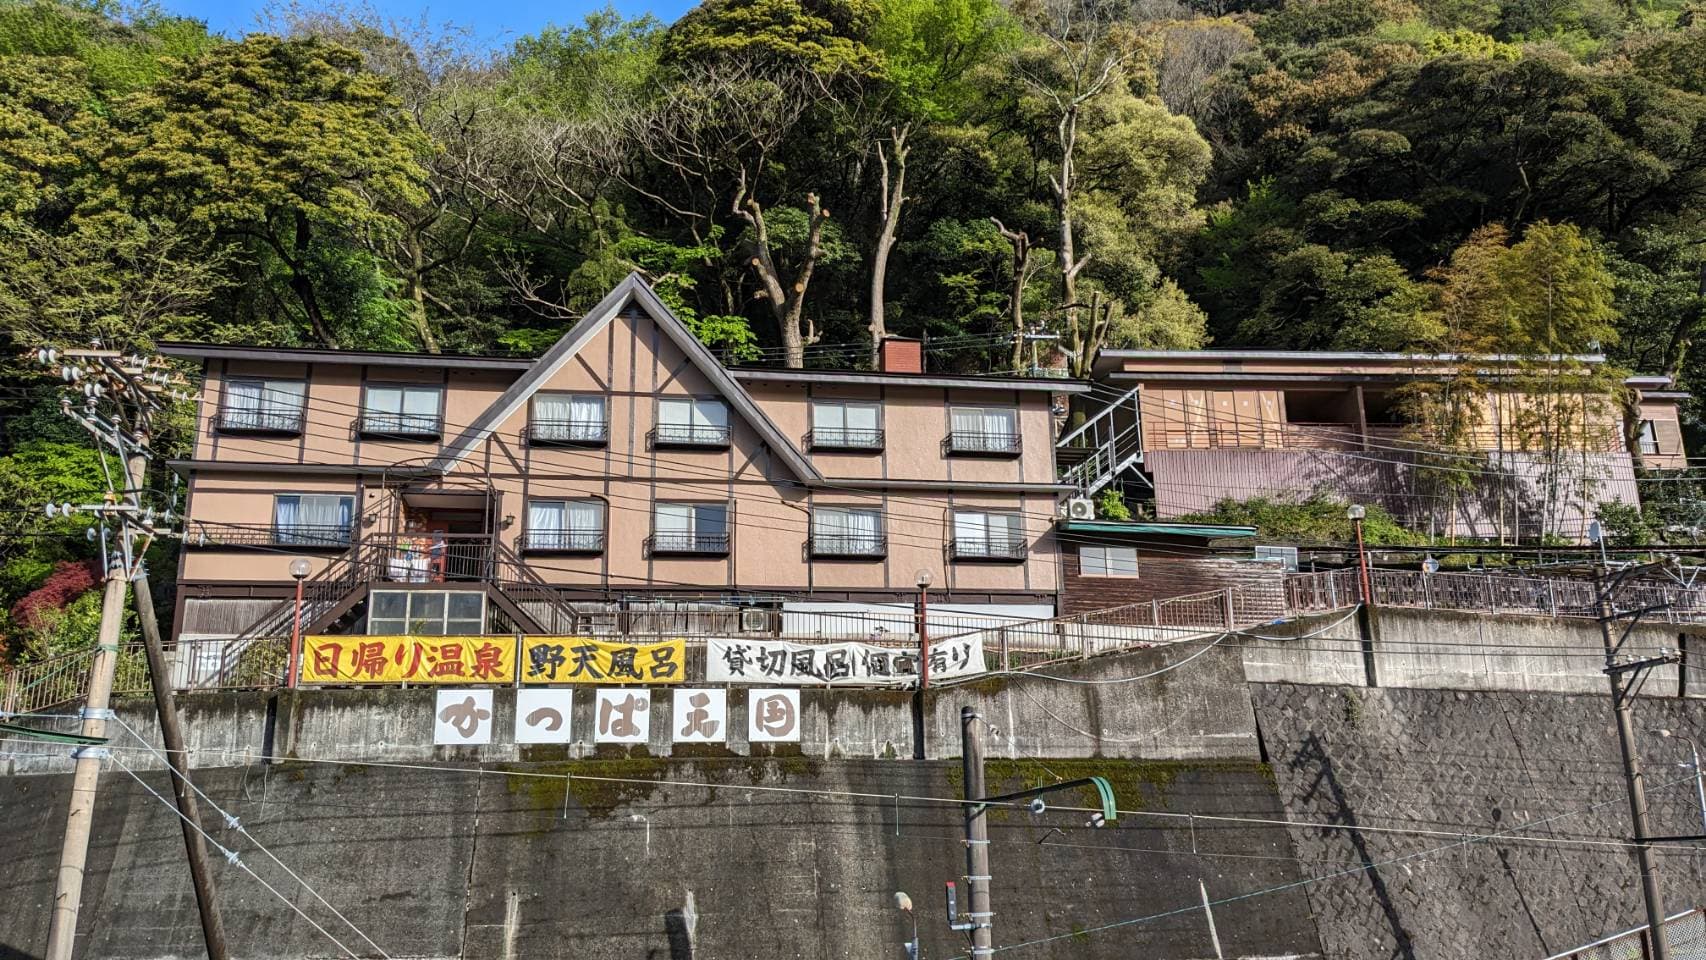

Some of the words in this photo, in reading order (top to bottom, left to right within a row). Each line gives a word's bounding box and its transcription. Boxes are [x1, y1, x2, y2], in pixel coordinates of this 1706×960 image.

[312, 642, 504, 680] 日帰り温泉
[528, 644, 679, 679] 野天風呂
